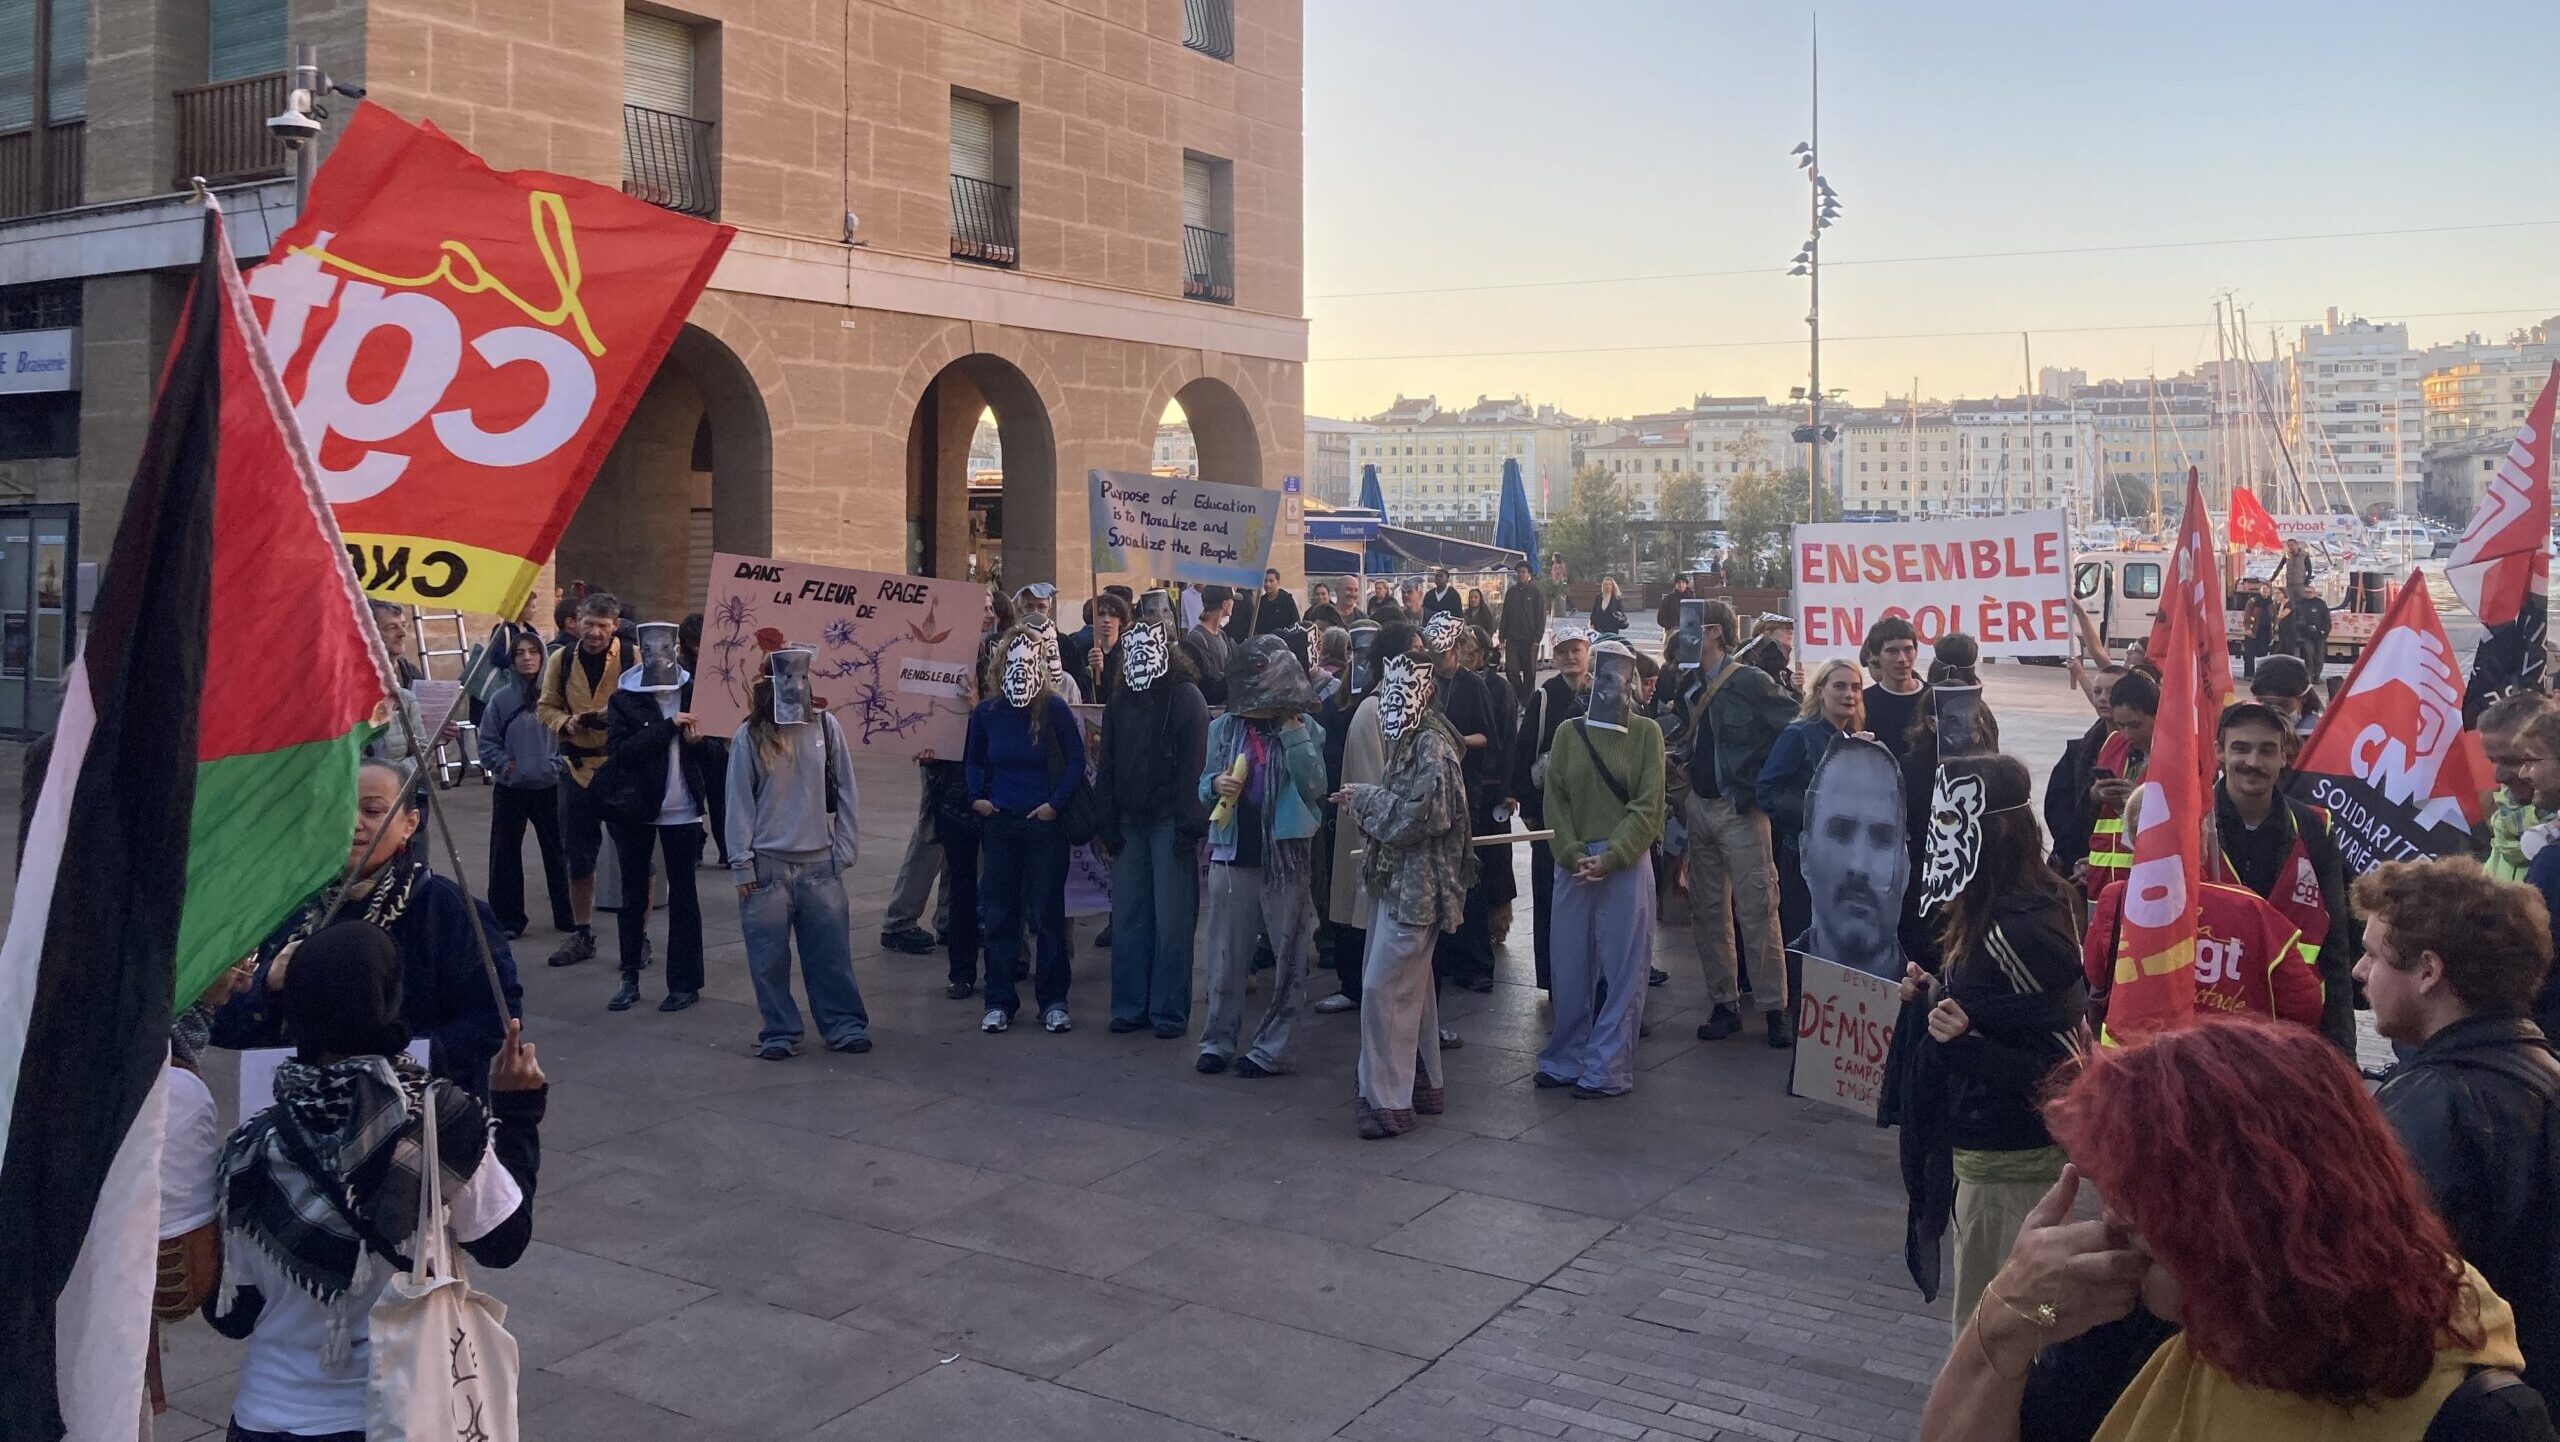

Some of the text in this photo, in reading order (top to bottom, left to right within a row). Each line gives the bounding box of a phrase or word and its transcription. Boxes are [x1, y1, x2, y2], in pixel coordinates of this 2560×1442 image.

[1100, 480, 1256, 514] Purpose of Education
[1113, 507, 1228, 535] is to Moralize and
[2277, 520, 2326, 533] rryboat
[1108, 527, 1237, 563] Socialize the People
[1801, 532, 2060, 584] ENSEMBLE
[734, 562, 928, 619] DANS LA FLEUR DE RAGE
[1804, 606, 1864, 646] EN
[2195, 937, 2244, 984] gt
